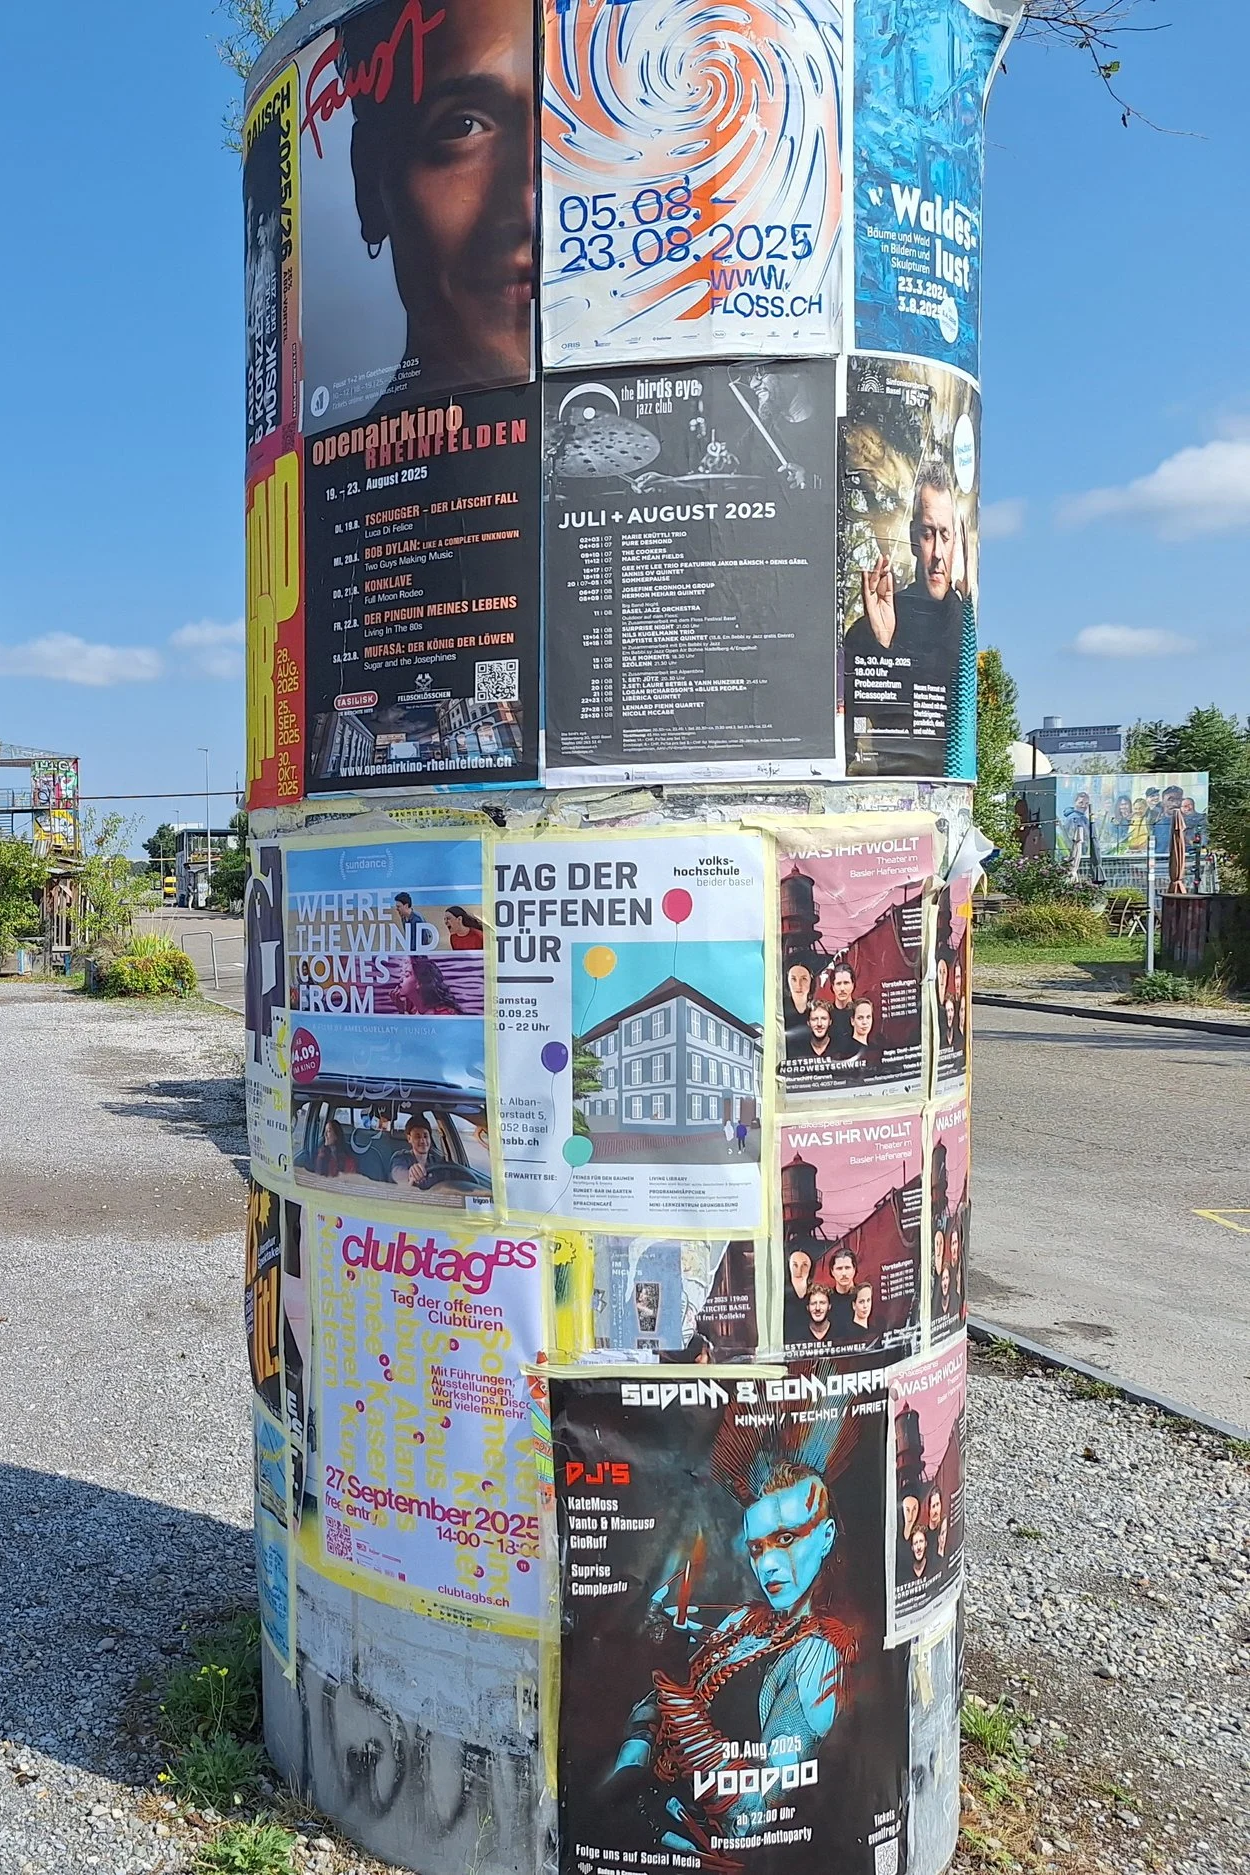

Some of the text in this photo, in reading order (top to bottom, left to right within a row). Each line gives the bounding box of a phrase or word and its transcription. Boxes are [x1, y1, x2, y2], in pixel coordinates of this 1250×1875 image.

[559, 186, 701, 233] 05.08.
[560, 223, 813, 273] 23.08.2025
[891, 256, 931, 275] Skulpturen
[935, 238, 970, 293] lust
[710, 292, 822, 318] FLOSS.CH
[264, 337, 278, 437] MUSIK
[621, 385, 634, 401] the
[635, 400, 673, 418] jazz club
[312, 405, 463, 466] openairkino
[365, 418, 528, 471] RHEINFELDEN
[326, 466, 428, 501] 19. 23. August 2025
[365, 492, 518, 527] TSCHUGGER DER LÄTSCHT FALL
[558, 502, 777, 529] JULI AUGUST 2025
[365, 522, 414, 538] Luca Felice
[364, 530, 520, 560] BOB DYLAN: COMPLETE UNKNOWN
[640, 538, 672, 546] DESMOND
[364, 550, 454, 572] Two Guys Making Music
[365, 574, 412, 593] KONKLAVE
[364, 588, 424, 605] Full Moon Rodeo
[364, 596, 517, 627] DER PINGUIN MEINES LEBENS
[661, 605, 701, 613] ORCHESTRA
[364, 622, 423, 638] Living The 80s
[364, 632, 514, 659] MUFASA: DER KÖNIG DER LÖWEN
[277, 662, 299, 678] AUG.
[363, 652, 457, 672] Sugar and the Josephines
[277, 676, 299, 694] 2025
[854, 679, 902, 689] Probezentrum
[397, 690, 451, 702] FELDSCHLÖSSCHEN
[854, 690, 897, 701] Picassoplatz
[278, 713, 298, 729] SEP.
[278, 728, 300, 745] 2025
[278, 765, 298, 781] OKT.
[340, 756, 512, 777] www.openairkino-rheinfelden.ch
[277, 780, 299, 797] 2025
[788, 837, 920, 860] WAS IHR WOLLT
[345, 859, 387, 870] sundance
[673, 866, 740, 877] hochschule
[698, 856, 734, 866] volks-
[495, 862, 637, 891] TAG DER
[296, 891, 392, 923] WHERE
[495, 897, 652, 928] OFFENEN
[295, 923, 440, 952] THE WIND
[495, 928, 561, 963] TÜR
[299, 954, 391, 985] COMES
[301, 986, 374, 1014] FROM
[492, 996, 537, 1008] Samstag
[492, 1009, 538, 1018] 20.09.25
[531, 1022, 550, 1032] Uhr
[779, 1059, 867, 1074] NORDWESTSCHWEIZ
[780, 1056, 831, 1067] FESTSPIELE
[522, 1124, 548, 1134] Basel
[788, 1121, 912, 1148] WAS IHR WOLLT
[499, 1136, 539, 1147] hsbb.ch
[874, 1140, 902, 1151] Theater
[390, 1289, 503, 1318] Tag der offenen
[428, 1310, 504, 1332] Clubtüren
[430, 1364, 516, 1388] Mit Führungen,
[900, 1376, 928, 1396] WAS
[430, 1376, 514, 1399] Ausstellungen,
[431, 1385, 498, 1407] Workshops,
[621, 1379, 728, 1409] SODOM
[431, 1397, 527, 1420] und vielem mehr.
[735, 1413, 774, 1427] KINKY
[791, 1408, 838, 1422] TECHNO
[566, 1461, 630, 1486] DJ'S
[325, 1491, 342, 1512] free
[568, 1496, 618, 1512] KateMoss
[474, 1507, 540, 1541] 2025
[568, 1515, 655, 1531] Vanto & Mancuso
[436, 1525, 480, 1548] 14:00
[570, 1535, 607, 1551] GioRuff
[571, 1563, 610, 1579] Suprise
[438, 1584, 510, 1608] clubtagbs.ch
[722, 1736, 802, 1760] 30.Aug.2025
[694, 1759, 819, 1800] VOODOO
[736, 1806, 796, 1826] ab 22:00 Uhr
[874, 1809, 896, 1828] Tickets
[710, 1826, 813, 1849] Dresscode-Mottoparty
[575, 1844, 701, 1869] Folge uns auf Social Media
